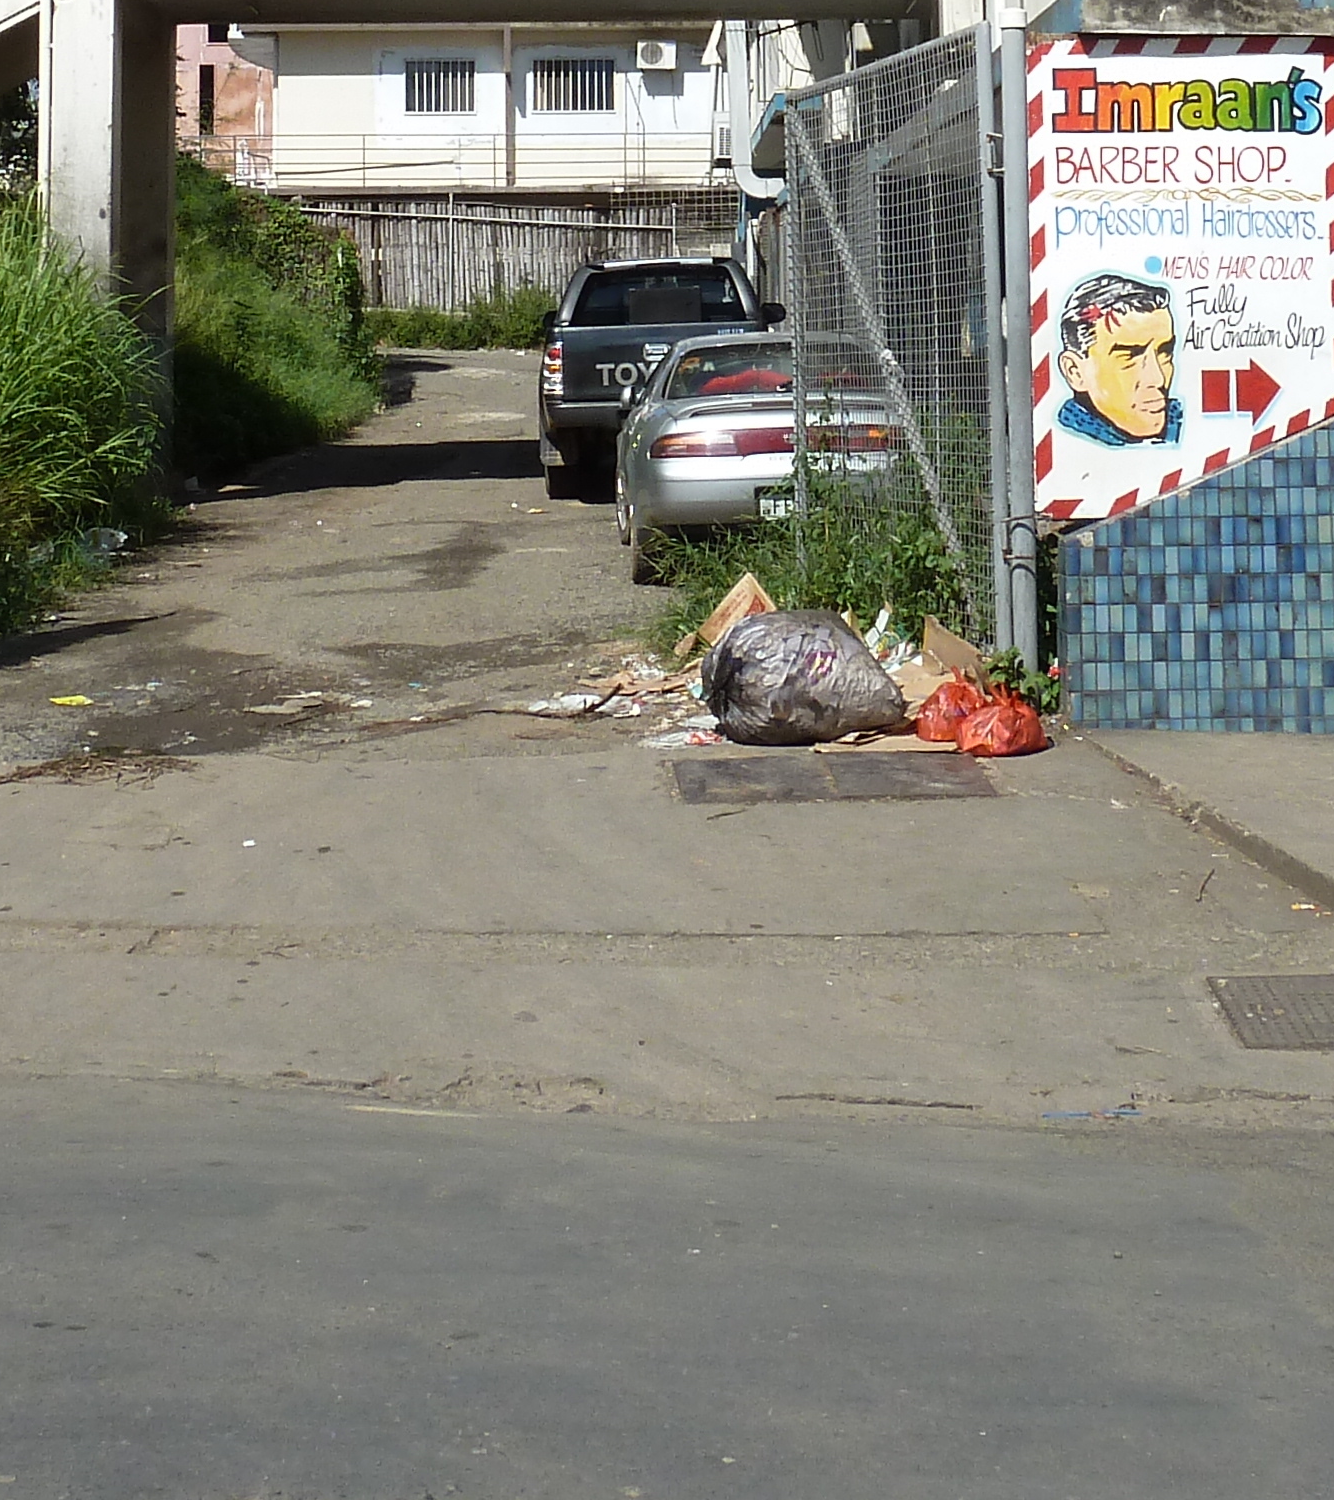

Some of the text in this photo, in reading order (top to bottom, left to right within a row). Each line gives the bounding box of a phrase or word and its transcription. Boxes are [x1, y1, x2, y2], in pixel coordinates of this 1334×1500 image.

[1052, 66, 1323, 135] Imraan's
[1056, 146, 1181, 184] BARBER
[1056, 200, 1190, 249] professional
[1217, 255, 1256, 280] HAIR
[1259, 256, 1315, 281] COLOR
[1186, 283, 1248, 326] Fully
[1183, 313, 1326, 359] Air Condition Shop
[595, 361, 659, 386] TOY
